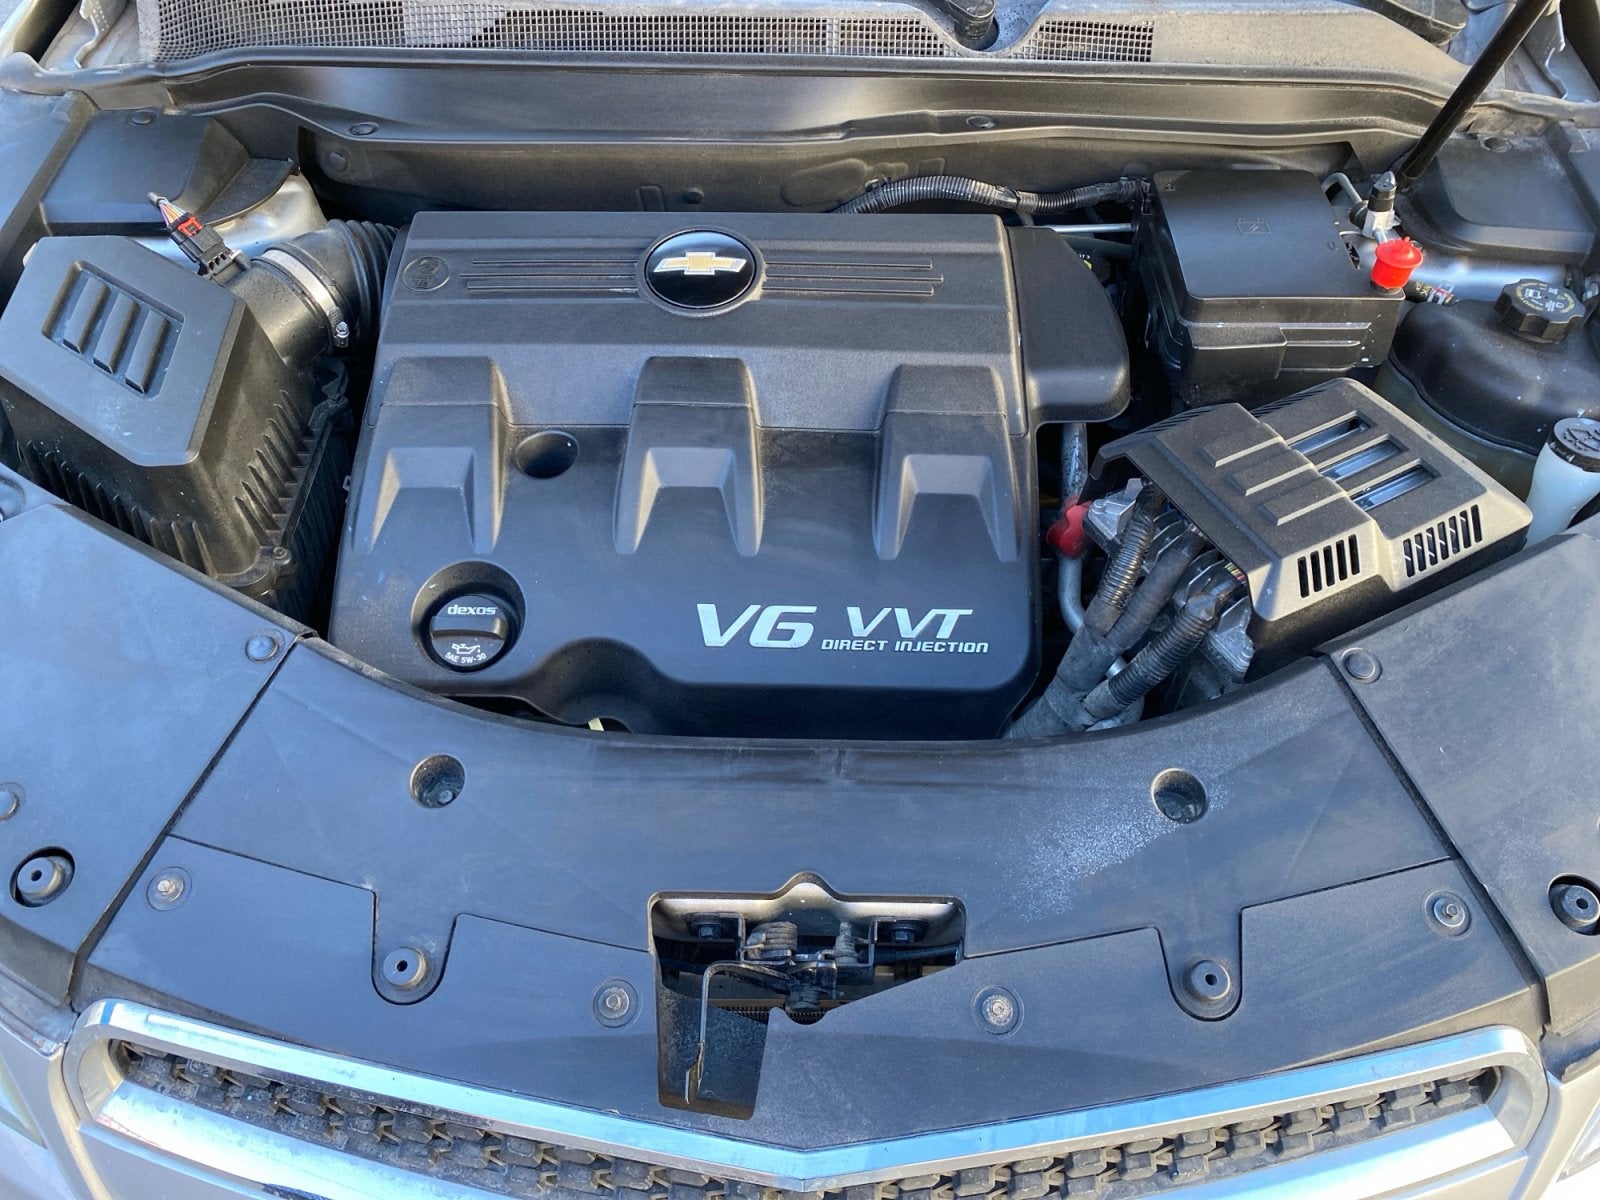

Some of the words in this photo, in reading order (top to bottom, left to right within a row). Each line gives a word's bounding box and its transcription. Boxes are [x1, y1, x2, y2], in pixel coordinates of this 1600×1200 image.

[447, 604, 498, 615] dexos
[697, 603, 817, 649] V6
[846, 606, 974, 639] VVT
[821, 639, 888, 652] DIRECT
[894, 640, 989, 654] INJECTION
[445, 651, 459, 662] SAE
[461, 653, 487, 663] 5W-30
